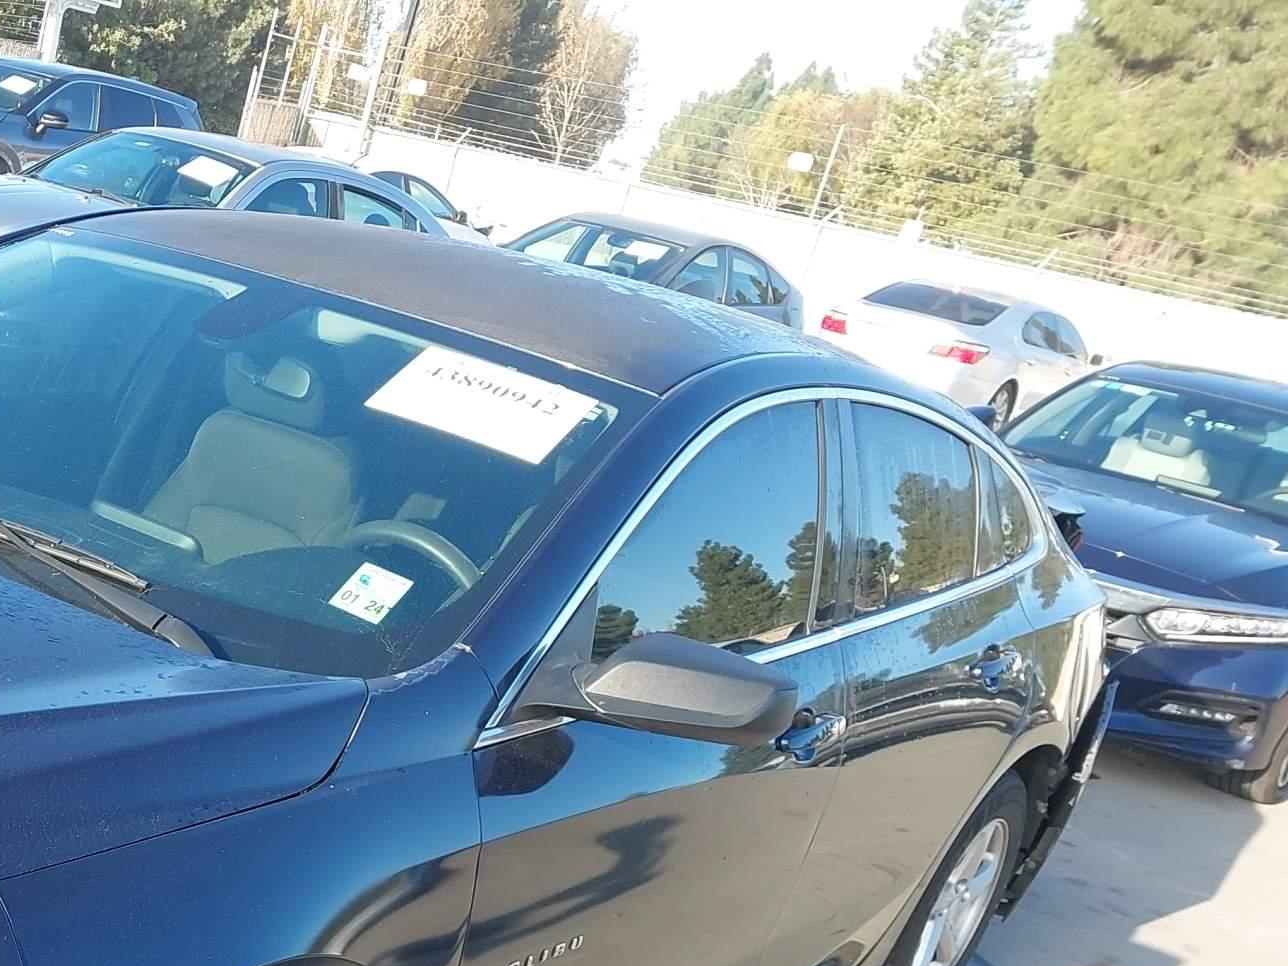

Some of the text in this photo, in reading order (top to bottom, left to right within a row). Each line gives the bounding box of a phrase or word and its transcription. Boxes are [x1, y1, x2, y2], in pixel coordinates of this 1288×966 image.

[426, 367, 560, 415] 43890942
[340, 590, 385, 615] 01 24
